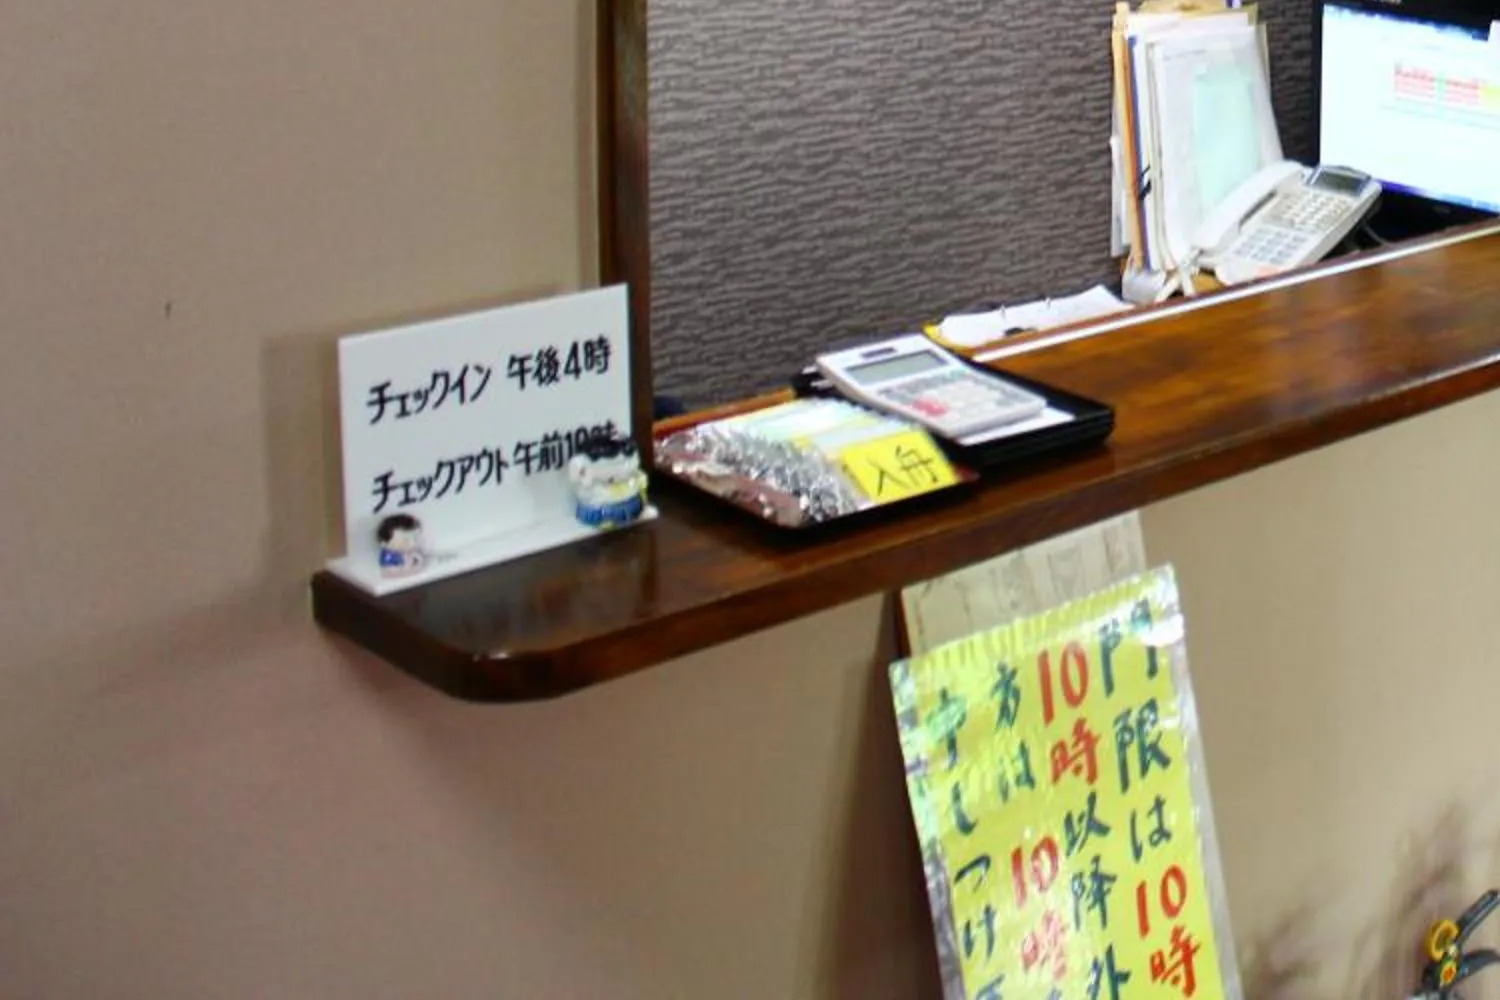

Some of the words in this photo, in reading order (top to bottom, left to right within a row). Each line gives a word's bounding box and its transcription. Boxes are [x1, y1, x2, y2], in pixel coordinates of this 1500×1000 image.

[366, 363, 491, 425] チェックイン
[506, 334, 611, 391] 午後4時
[372, 447, 509, 513] チェックアウト
